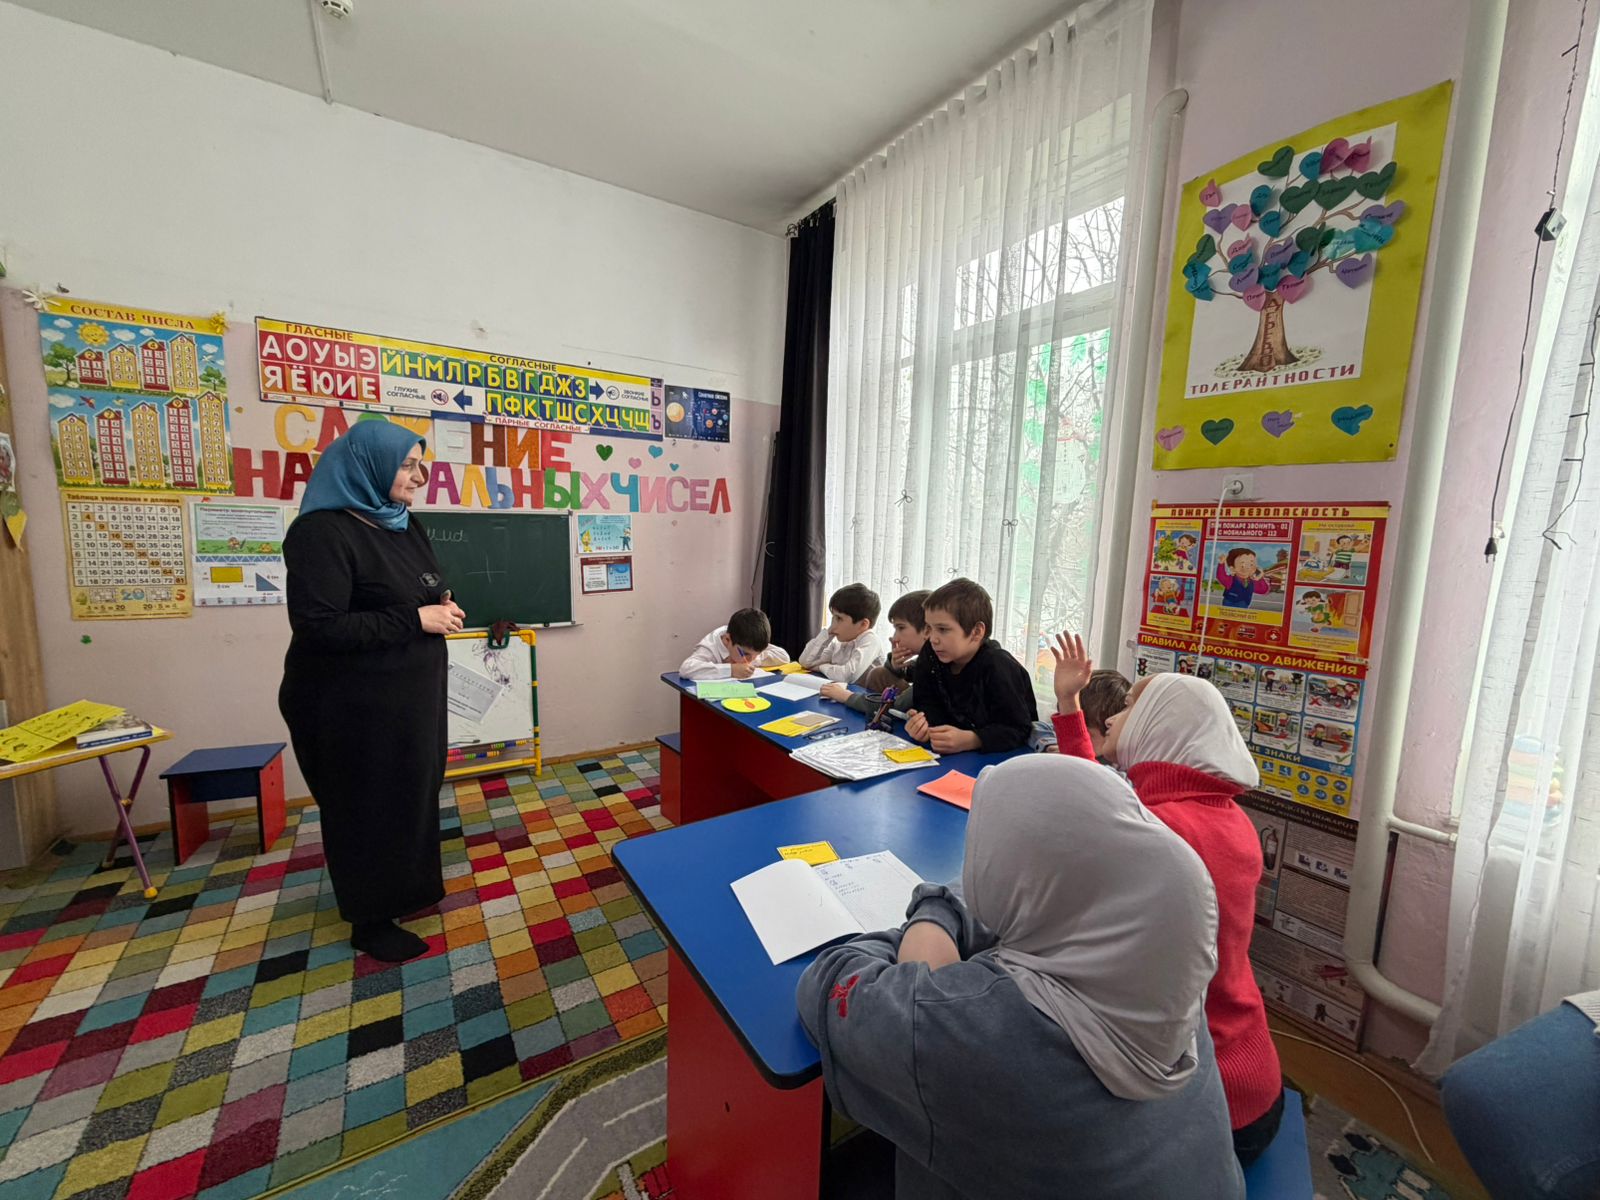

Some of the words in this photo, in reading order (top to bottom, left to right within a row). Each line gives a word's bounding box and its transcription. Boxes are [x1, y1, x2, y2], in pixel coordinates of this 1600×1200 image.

[70, 304, 136, 322] СОСТАВ
[142, 314, 195, 330] ЧИСЛА
[286, 323, 353, 342] ГЛАСНЫЕ
[489, 355, 558, 372] СОГЛАСНЫЕ
[1191, 364, 1355, 394] ТОЛЕРАНТНОСТИ
[386, 390, 426, 400] СОГЛАСНЫЕ
[394, 385, 418, 394] ГЛУХИЕ
[495, 418, 530, 427] ПАРНЫЕ
[534, 422, 581, 432] СОГЛАСНЫЕ
[274, 404, 572, 472] СЛЕНИЕ
[232, 447, 610, 510] НААЛЬНЫХ
[610, 472, 732, 514] ЧИСЕЛ
[1239, 508, 1350, 517] БЕЗОПАСНОСТЬ
[1140, 635, 1186, 650] ПРАВИЛА
[1189, 642, 1270, 663] ДОРОЖНОГО
[1273, 656, 1358, 675] ДВИЖЕНИЯ
[1264, 748, 1300, 763] ЗНАКИ
